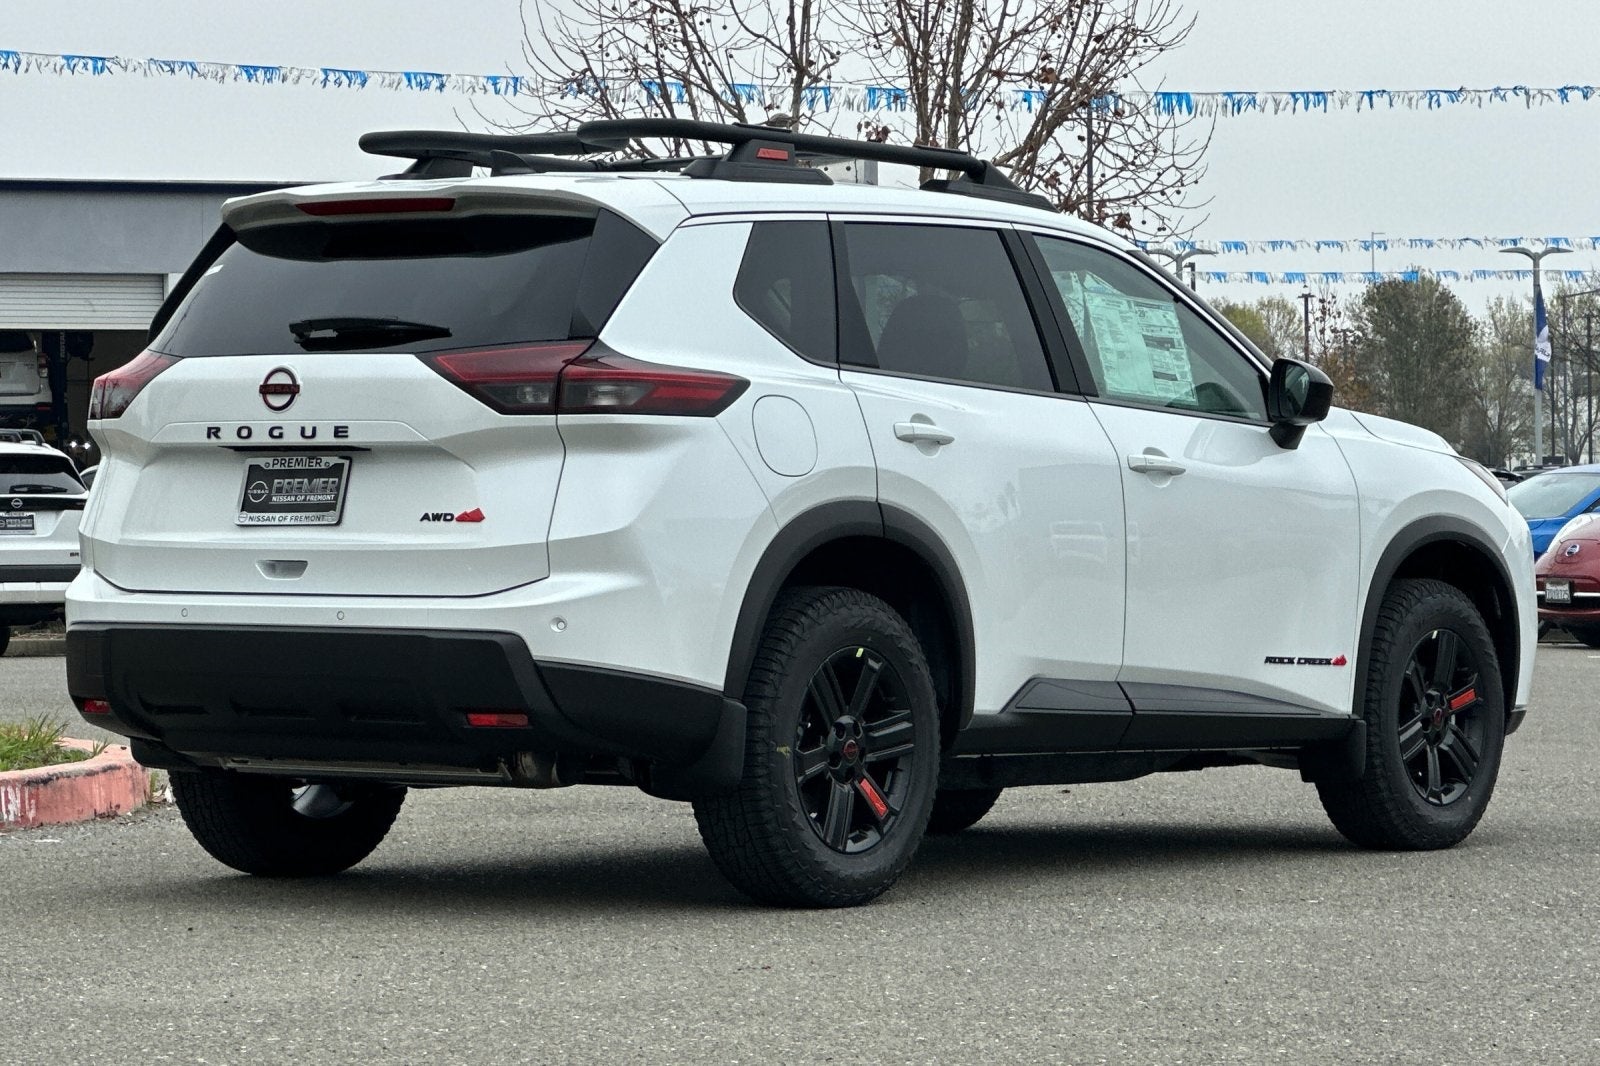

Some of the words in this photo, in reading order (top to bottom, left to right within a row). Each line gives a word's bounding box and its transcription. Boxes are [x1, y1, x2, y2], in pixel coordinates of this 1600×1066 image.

[207, 426, 349, 439] ROGUE
[272, 457, 322, 468] PREMIER
[272, 478, 338, 494] PREMIER
[420, 512, 455, 522] AWD
[1264, 656, 1295, 665] ROCK
[1297, 657, 1332, 666] CREEK
